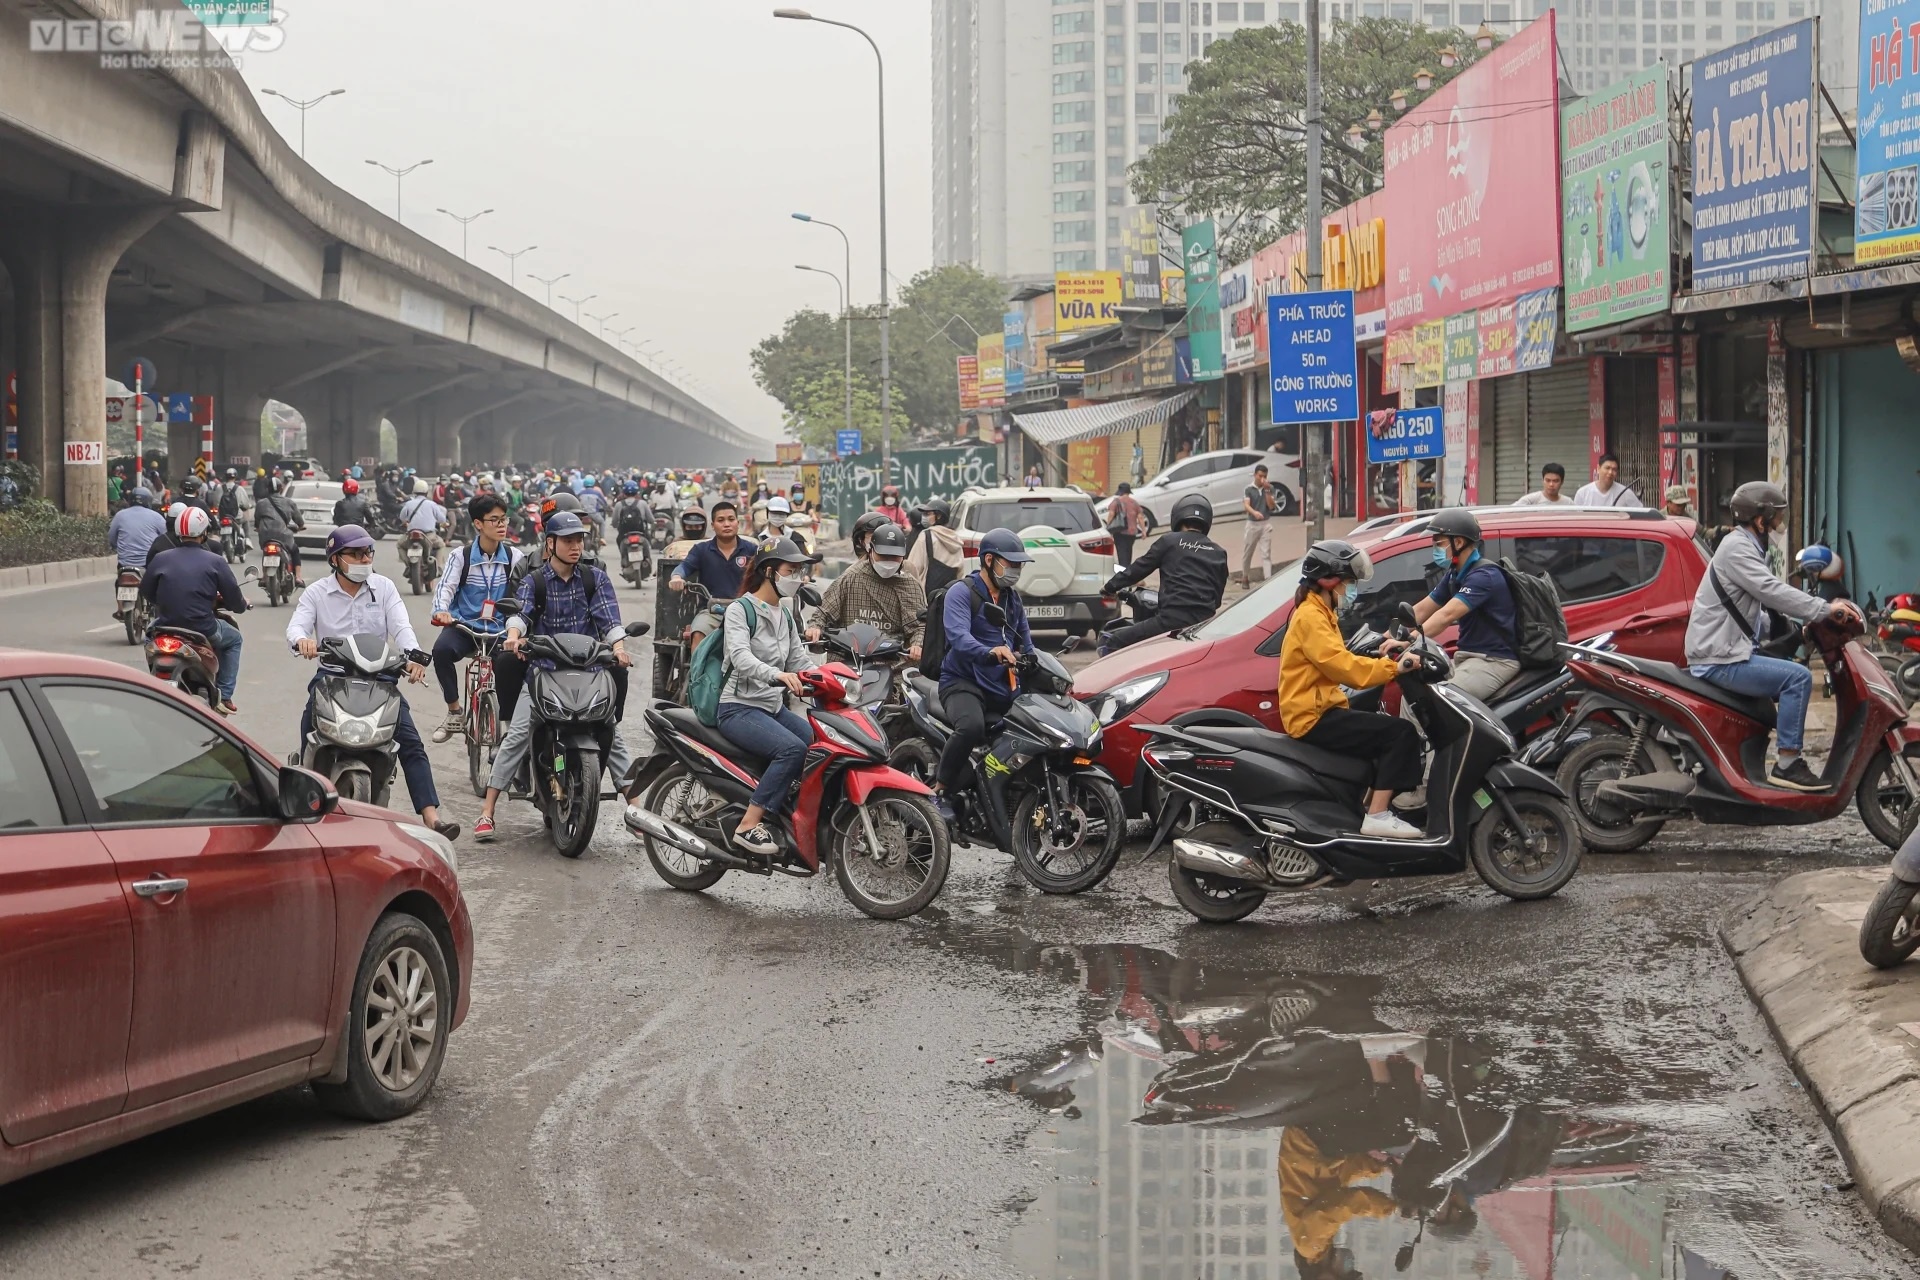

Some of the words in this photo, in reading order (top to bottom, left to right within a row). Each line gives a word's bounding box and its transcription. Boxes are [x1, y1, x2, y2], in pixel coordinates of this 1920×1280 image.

[1869, 16, 1903, 94] HÀ
[1695, 107, 1725, 196] HÀ
[1729, 90, 1808, 188] THÀNH
[1436, 202, 1457, 239] SONG
[1457, 190, 1480, 229] HONG
[1730, 199, 1751, 223] DOANH
[1751, 188, 1762, 218] SẮT
[1777, 186, 1790, 213] XÂY
[1790, 185, 1808, 213] DỰNG
[1744, 228, 1756, 255] TÔN
[1768, 222, 1781, 249] CÁC
[1059, 299, 1096, 319] VỮA
[1278, 303, 1304, 322] PHÍA
[1309, 300, 1346, 320] TRƯỚC
[1291, 328, 1332, 345] AHEAD
[1451, 336, 1474, 359] -70%
[1485, 329, 1513, 351] -50%
[1274, 376, 1304, 392] CÔNG
[1308, 371, 1352, 390] TRƯỜNG
[1294, 398, 1338, 414] WORKS
[1408, 415, 1433, 438] 250
[67, 444, 100, 462] NB2.7
[859, 609, 884, 620] MIAV
